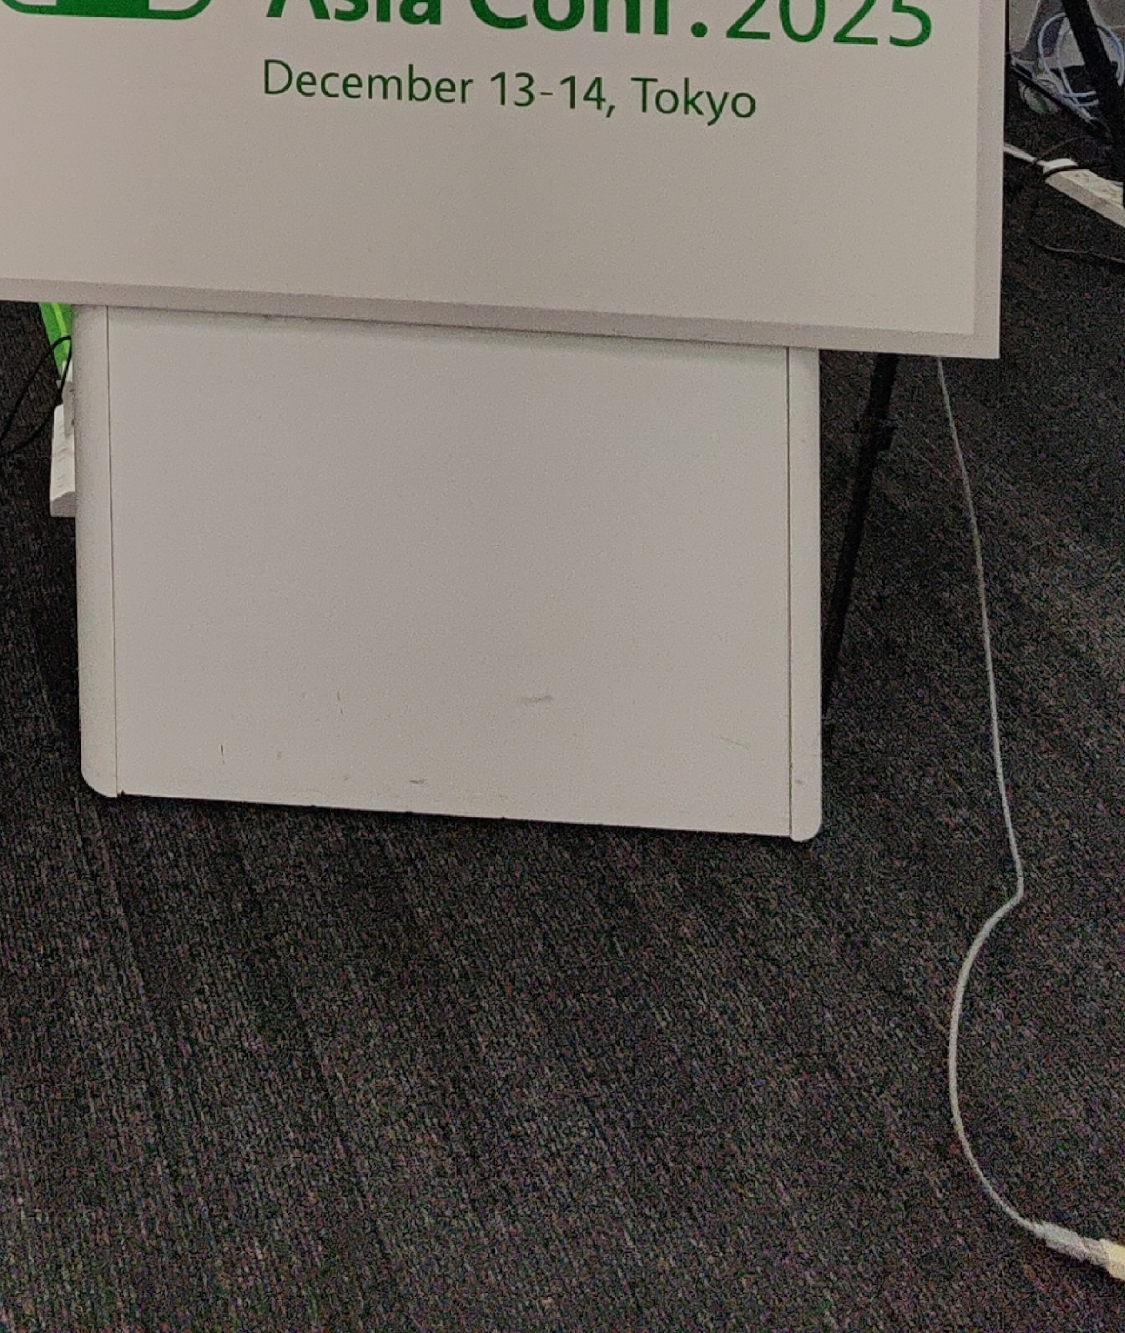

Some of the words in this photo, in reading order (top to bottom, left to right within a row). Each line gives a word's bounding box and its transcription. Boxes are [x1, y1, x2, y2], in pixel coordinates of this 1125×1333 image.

[262, 58, 474, 106] December
[491, 72, 616, 118] 13-14,
[631, 78, 758, 126] Tokyo
